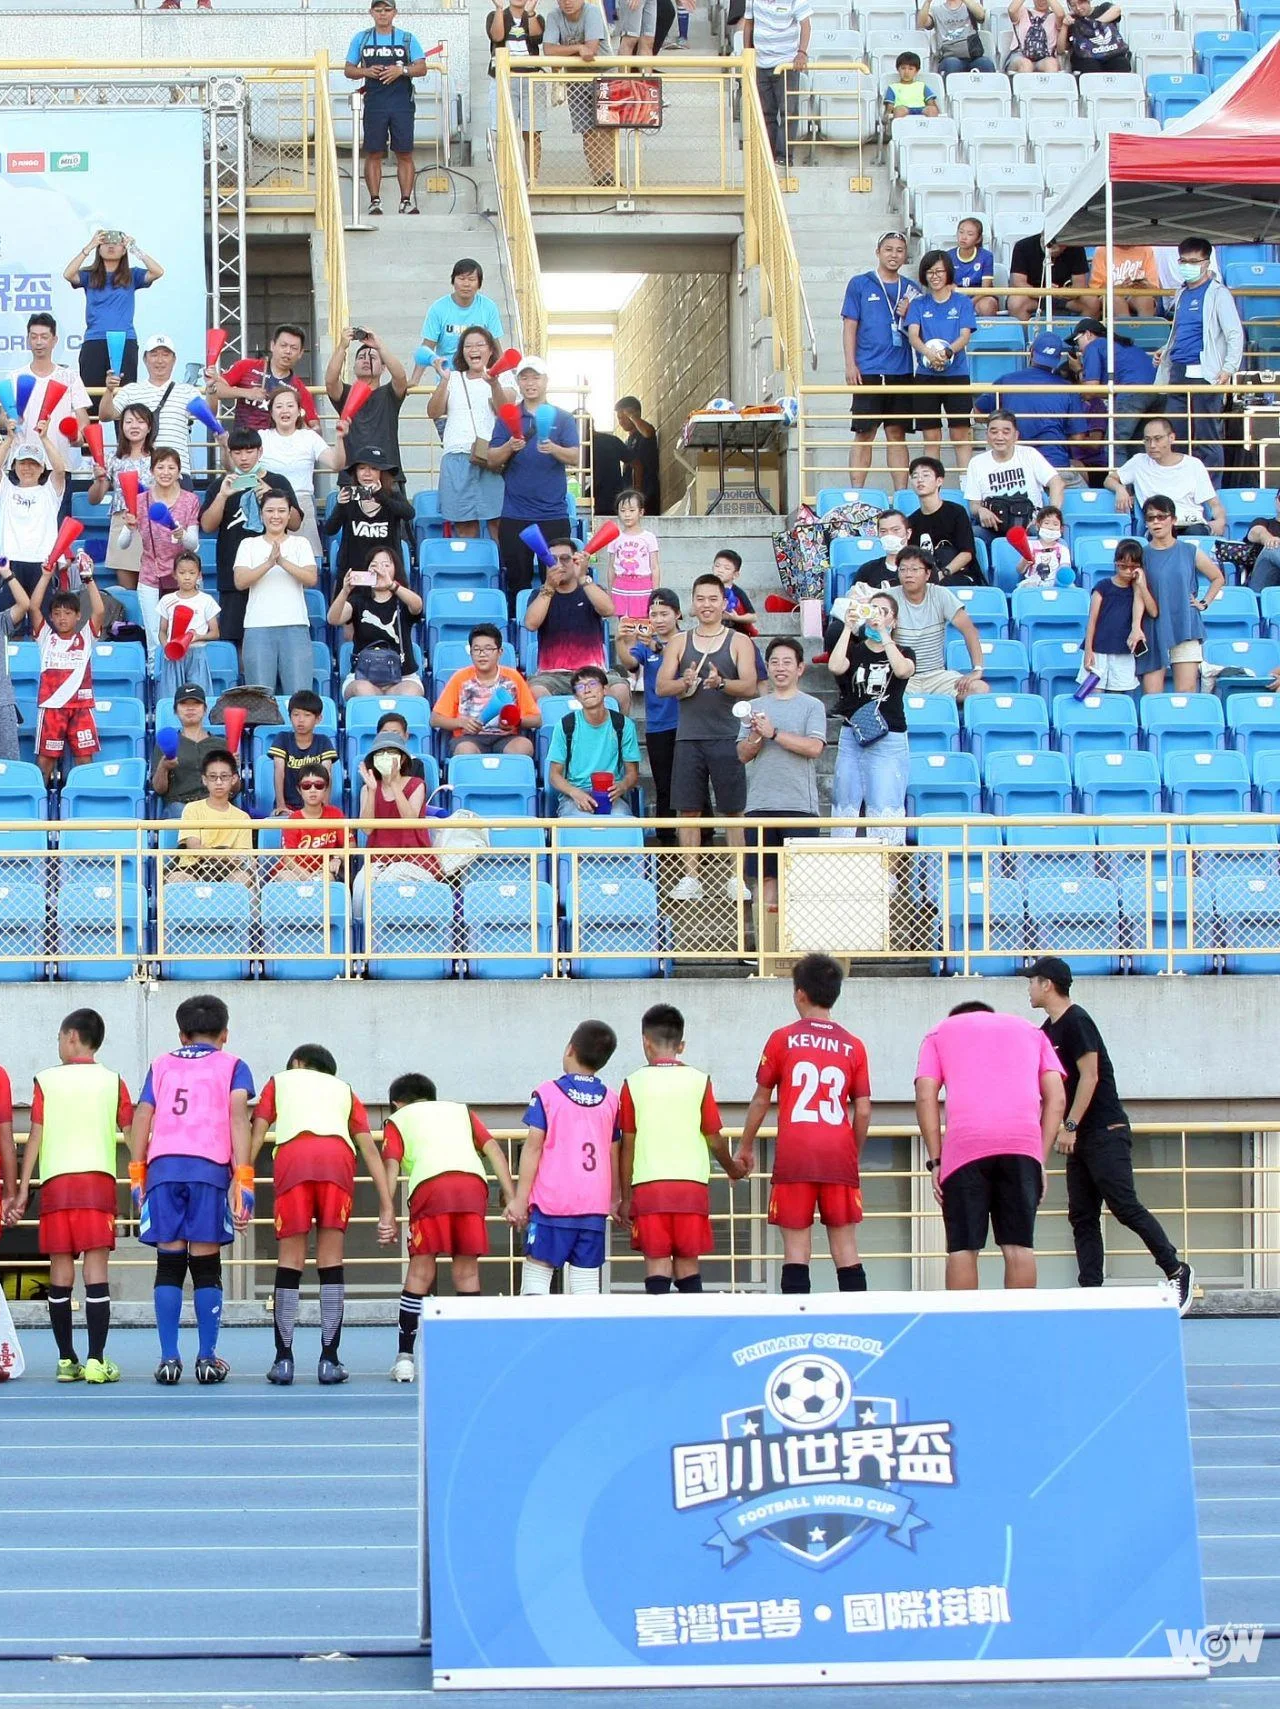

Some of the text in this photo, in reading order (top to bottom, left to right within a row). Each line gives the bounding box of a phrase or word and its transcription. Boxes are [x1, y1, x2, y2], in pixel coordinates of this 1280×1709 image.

[363, 46, 405, 57] umbro
[1092, 43, 1118, 54] adidas
[988, 467, 1025, 485] PUMA
[352, 521, 389, 538] VANS
[77, 729, 93, 742] 96
[787, 1034, 853, 1057] KEVIN T
[172, 1088, 189, 1116] 5
[790, 1060, 846, 1126] 23
[582, 1142, 597, 1171] 3
[733, 1333, 885, 1366] PRIMARY SCHOOL
[673, 1423, 954, 1509] 國小世界盃
[737, 1494, 896, 1526] FOOTBALL WORLD CUP
